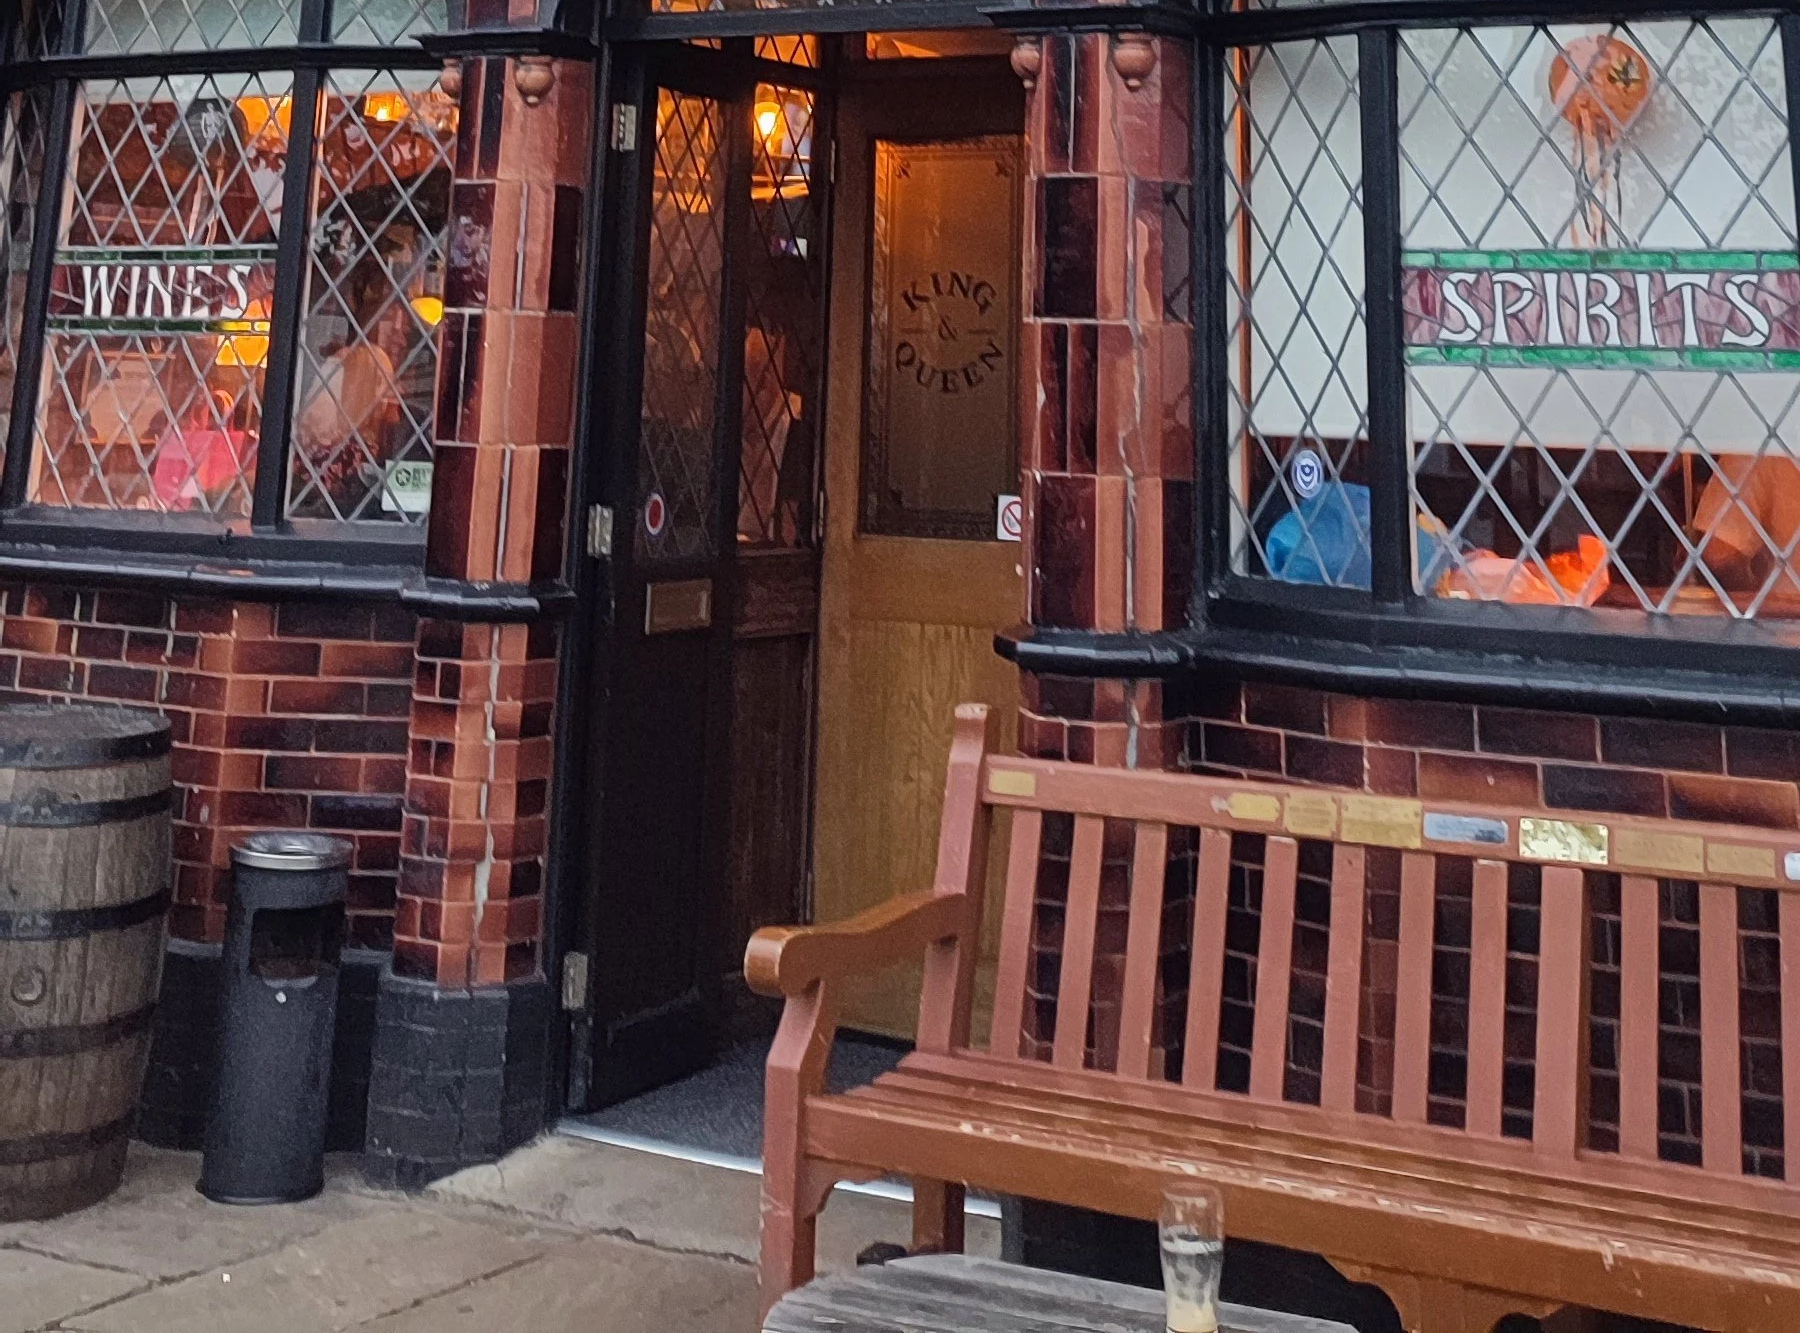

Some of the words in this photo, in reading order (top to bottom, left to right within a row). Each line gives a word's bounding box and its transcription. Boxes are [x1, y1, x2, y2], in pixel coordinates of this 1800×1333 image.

[82, 264, 251, 319] WINES
[901, 270, 998, 316] KING
[1438, 271, 1771, 347] SPIRITS
[895, 338, 1004, 395] QUEEN
